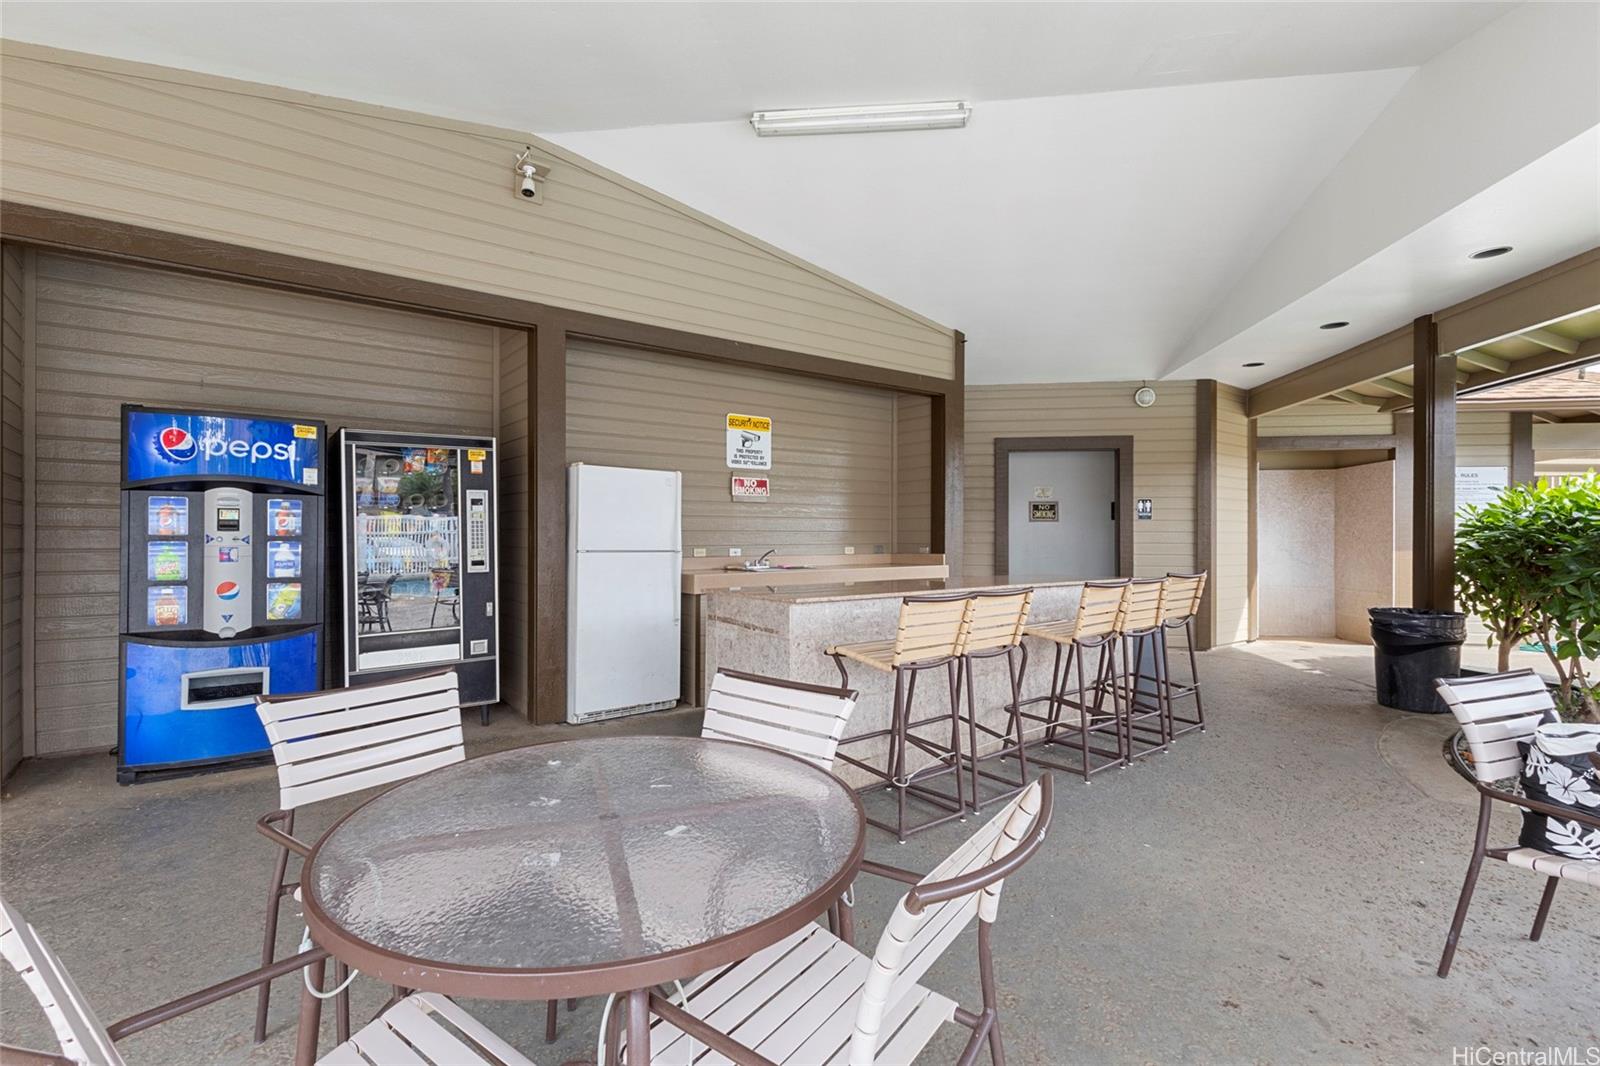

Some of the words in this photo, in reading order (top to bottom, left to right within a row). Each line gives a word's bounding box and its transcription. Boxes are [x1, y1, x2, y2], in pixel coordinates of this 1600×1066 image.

[728, 418, 752, 428] SECURITY
[753, 421, 770, 430] NOTICE
[203, 437, 297, 464] pepsi
[744, 479, 757, 487] NO
[735, 487, 767, 495] SMOKING
